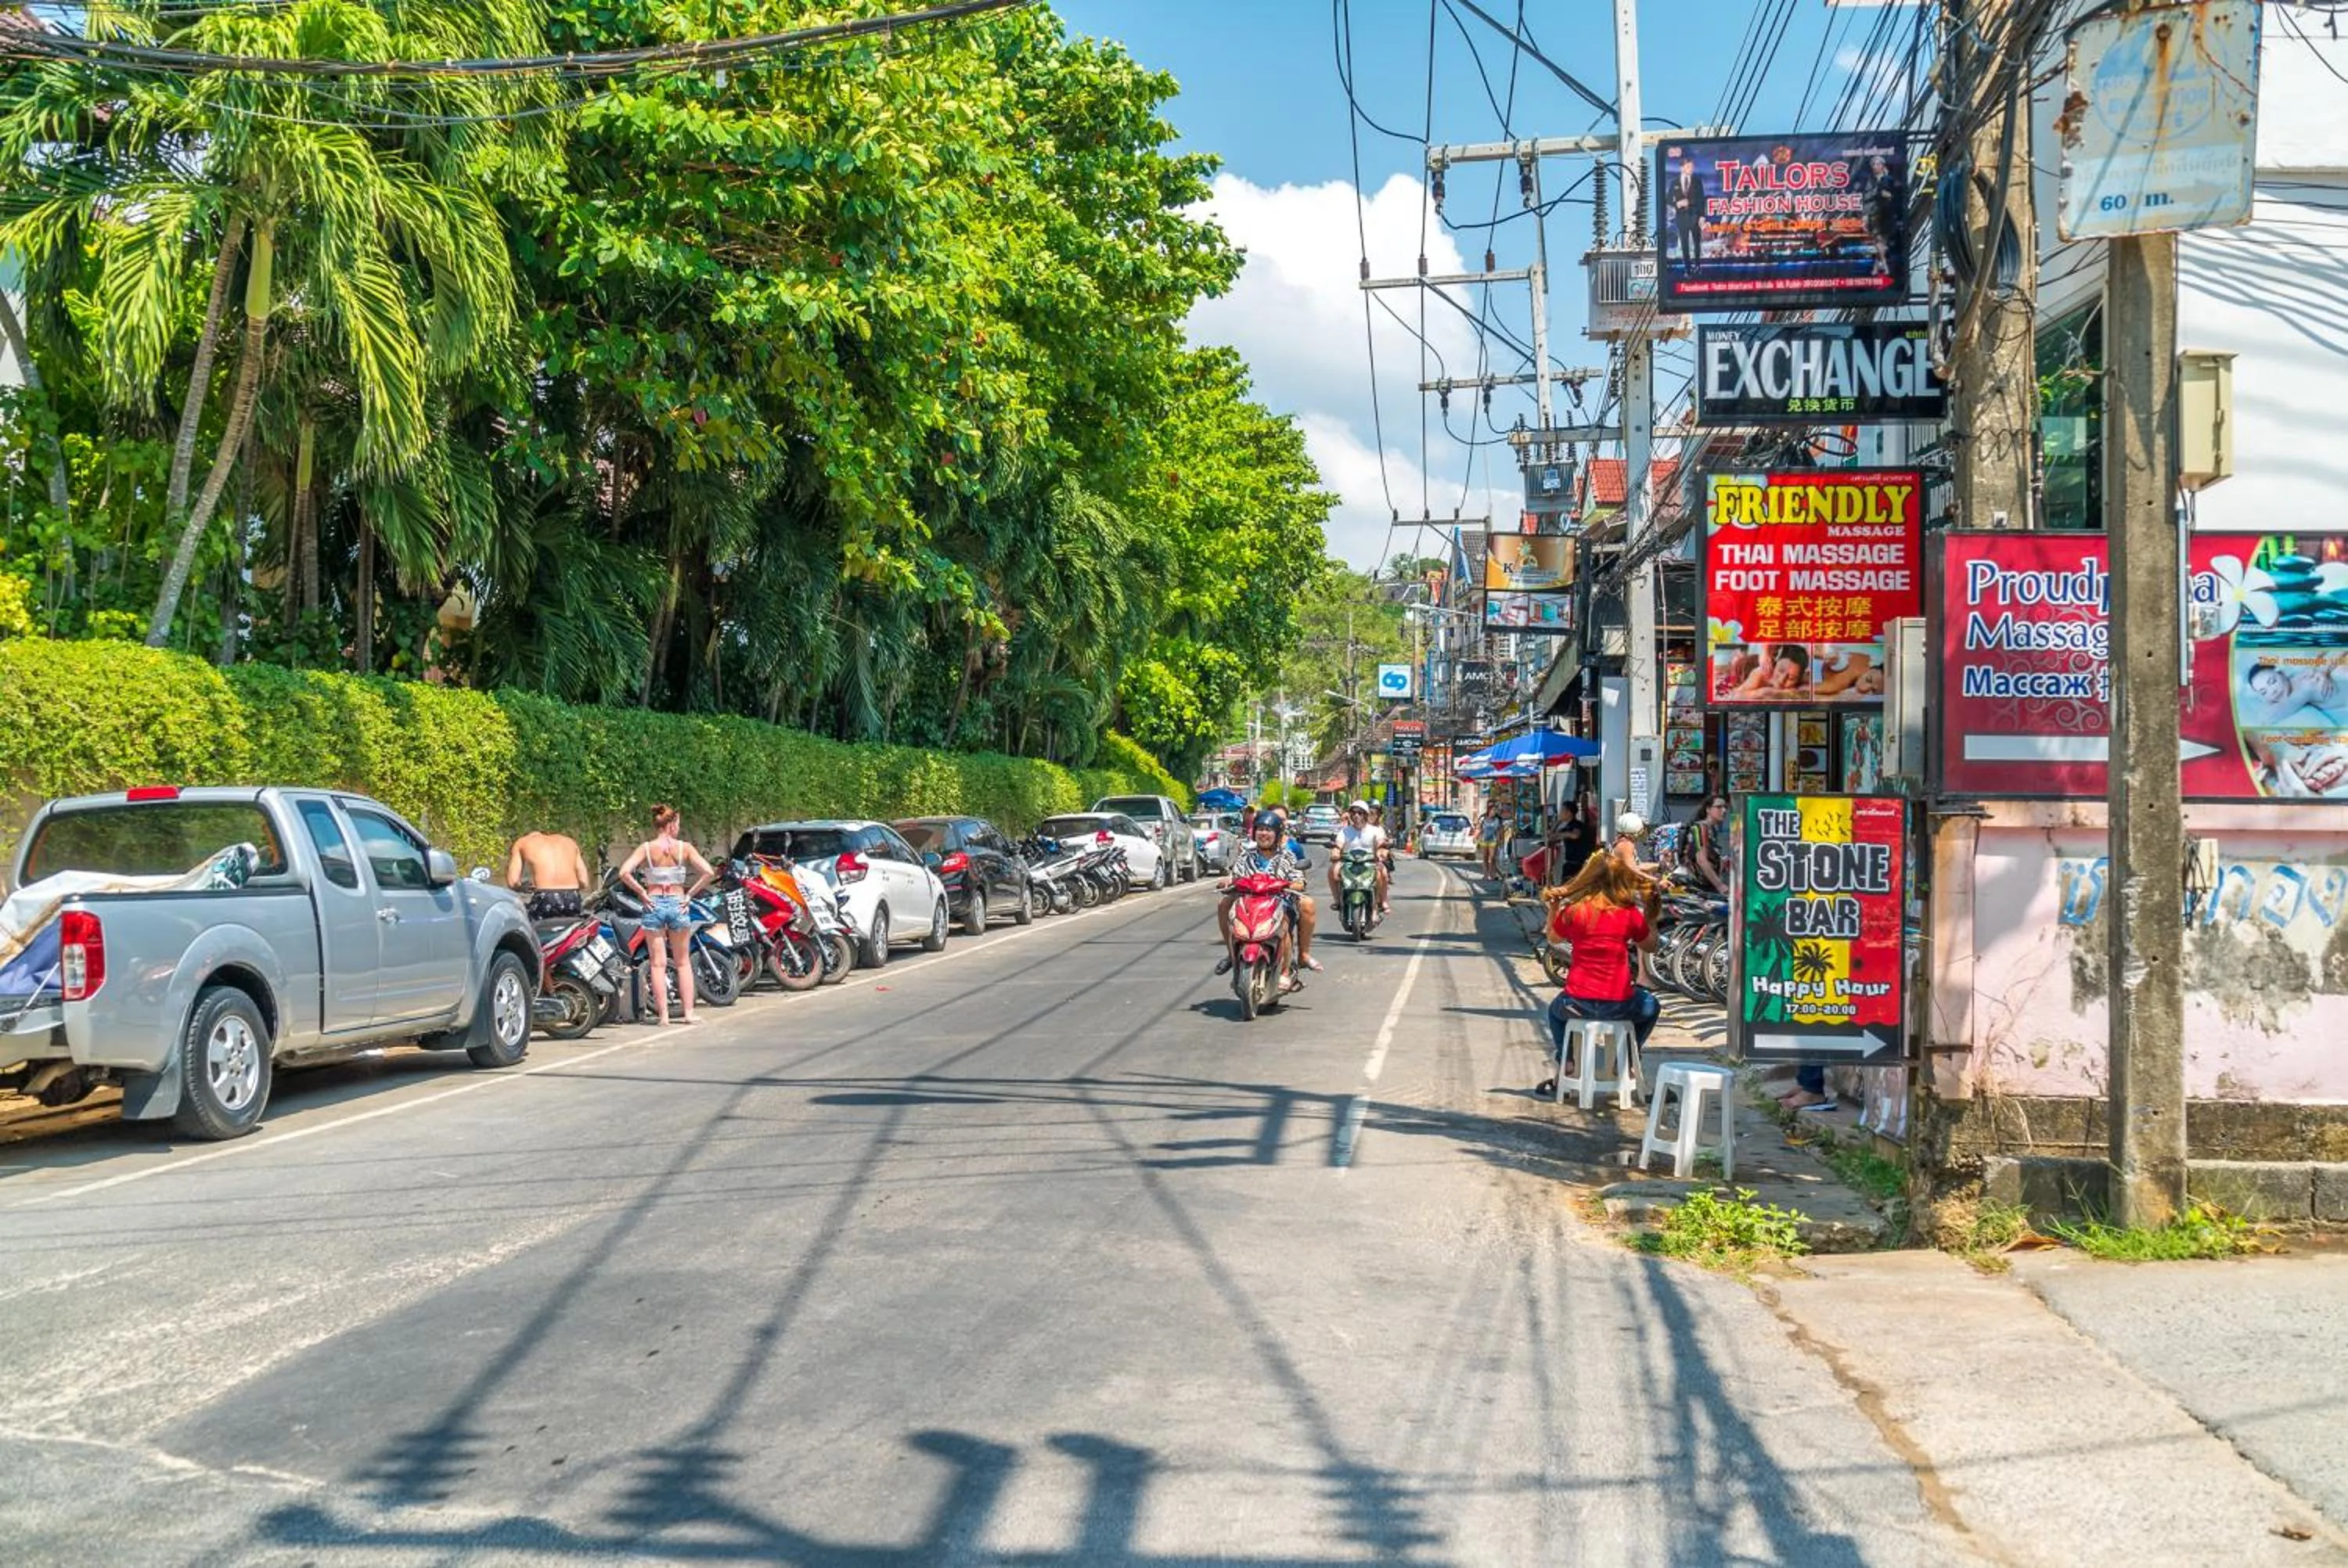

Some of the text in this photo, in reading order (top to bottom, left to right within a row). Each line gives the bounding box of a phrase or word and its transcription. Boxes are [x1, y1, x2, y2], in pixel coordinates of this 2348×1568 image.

[1716, 159, 1850, 192] TAILORS
[1706, 193, 1864, 215] FASHION HOUSE
[2099, 194, 2127, 211] 60
[1705, 331, 1741, 342] MONEY
[1705, 338, 1940, 399] EXCHANGE
[1788, 398, 1855, 412] 兑换货币
[1714, 484, 1913, 525] FRIENDLY
[1827, 525, 1905, 537] MASSAGE
[1718, 543, 1905, 564] THAI MASSAGE
[1715, 570, 1910, 591] FOOT MASSAGE
[1756, 595, 1872, 617] 泰式按摩
[1756, 619, 1872, 639] 足部按摩
[1965, 612, 2109, 660] Massag
[1962, 665, 2092, 698] Массаж
[1759, 808, 1802, 838] THE
[1756, 840, 1891, 892] STONE
[1785, 897, 1860, 937] BAR
[1752, 976, 1890, 998] Happy Hour
